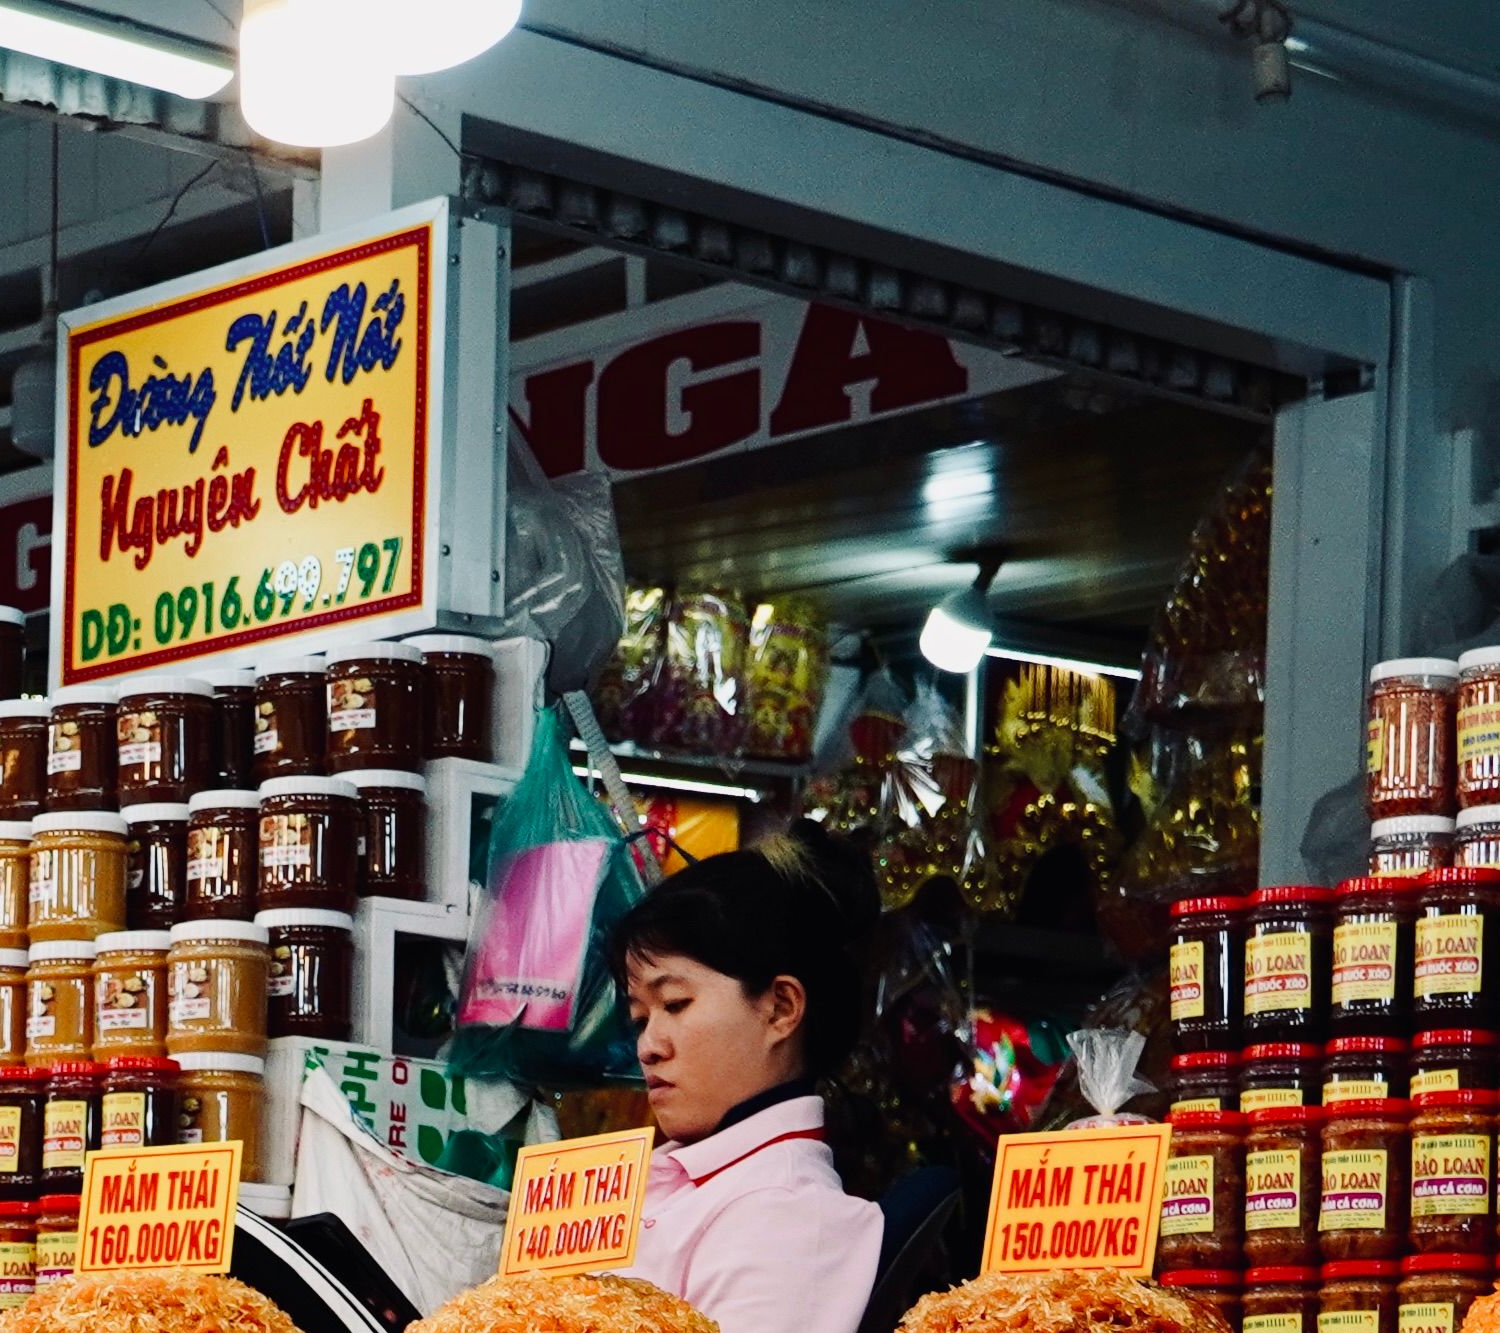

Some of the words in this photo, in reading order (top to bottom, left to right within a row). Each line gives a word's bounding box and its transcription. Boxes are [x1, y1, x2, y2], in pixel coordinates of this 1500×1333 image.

[88, 344, 216, 453] Đường
[224, 298, 314, 400] Thốt
[322, 278, 405, 387] Nốt
[99, 445, 260, 573] Nguyên
[275, 398, 384, 516] Chất
[80, 606, 143, 662] DĐ:
[154, 536, 404, 646] 0916.699.797
[100, 1157, 158, 1216] MẮM
[167, 1158, 220, 1211] THÁI
[522, 1157, 580, 1215] MẮM
[583, 1150, 635, 1206] THÁI
[1008, 1155, 1075, 1212] MẮM
[1080, 1155, 1146, 1206] THÁI
[1443, 1156, 1486, 1176] LOAN
[88, 1218, 221, 1267] 160.000/KG
[516, 1213, 627, 1263] 140.000/KG
[1000, 1218, 1139, 1264] 150.000/KG
